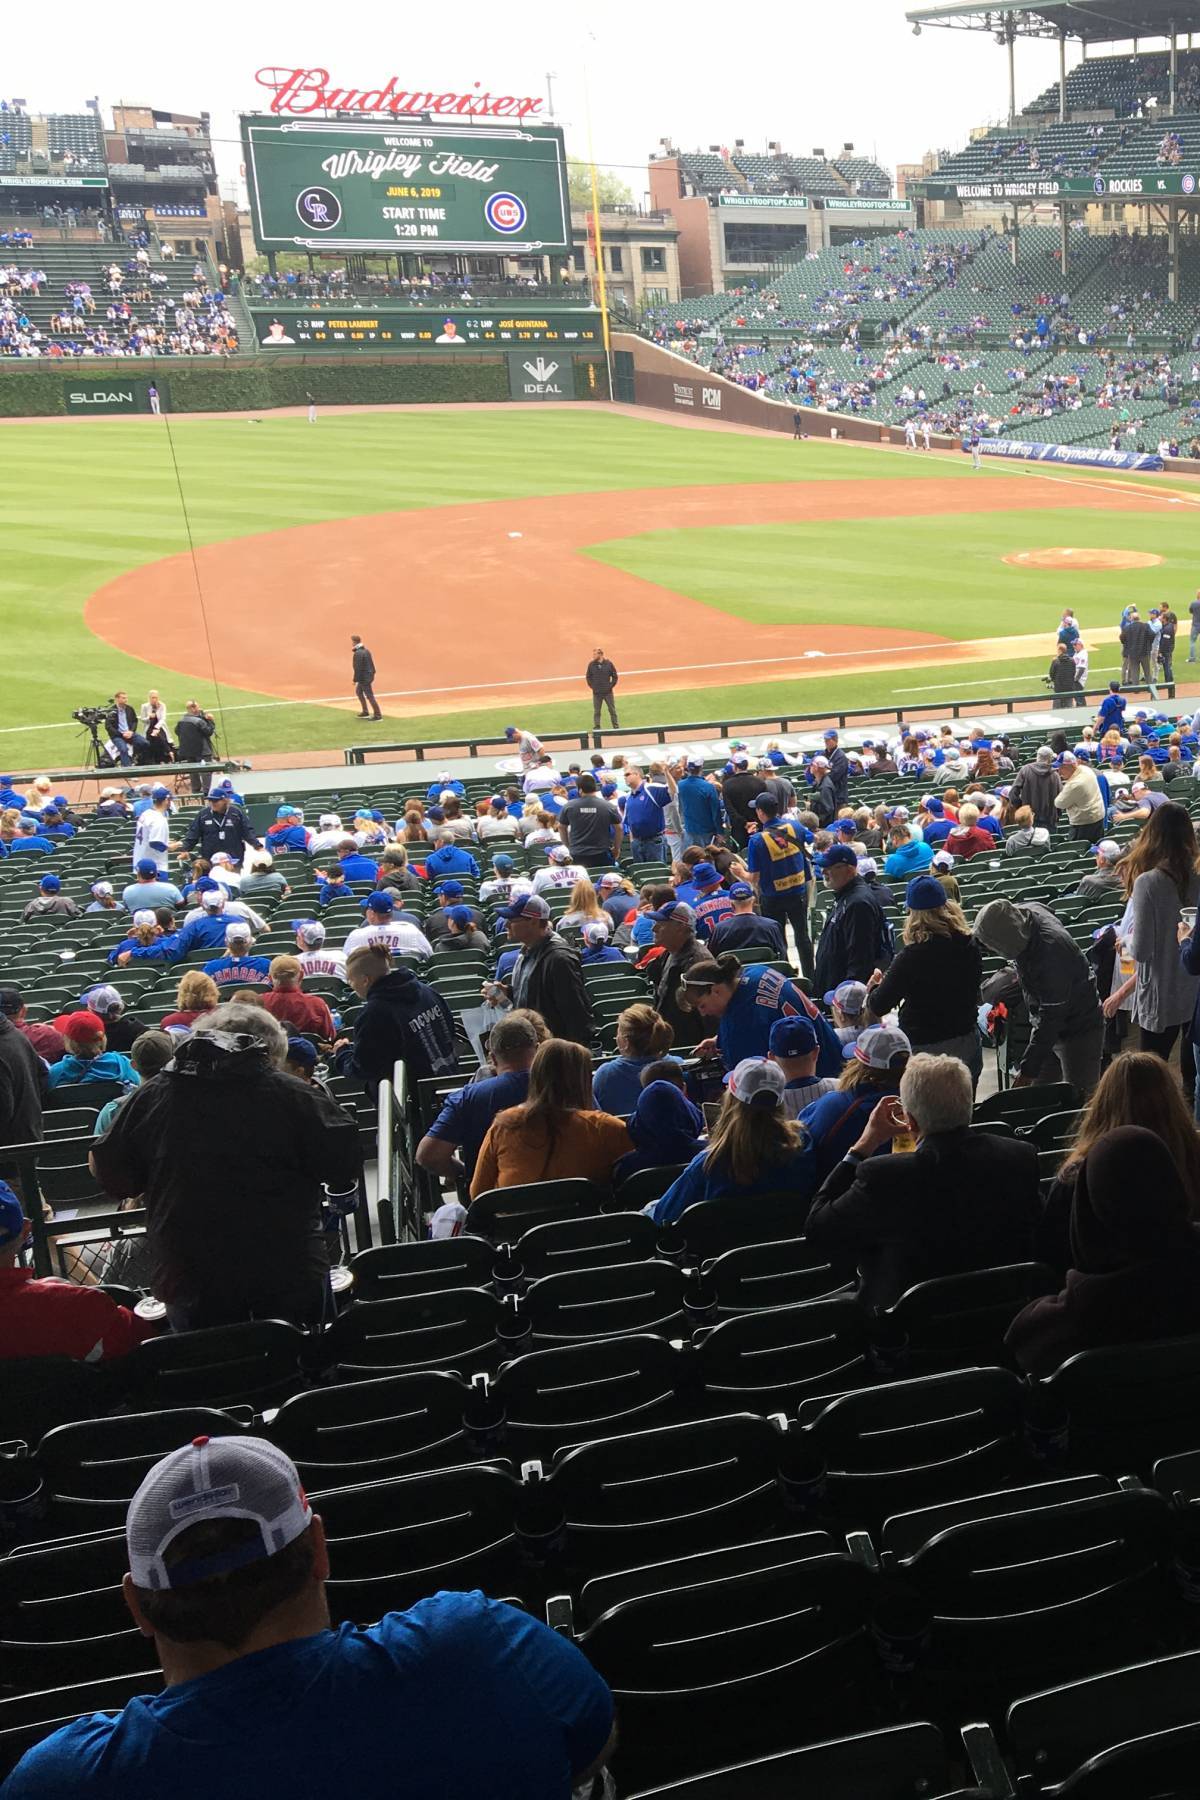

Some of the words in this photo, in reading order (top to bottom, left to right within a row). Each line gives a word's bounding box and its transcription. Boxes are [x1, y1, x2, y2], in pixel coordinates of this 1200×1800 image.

[255, 67, 543, 117] Budweiser
[384, 137, 423, 148] WELCOME
[423, 138, 434, 148] TO
[321, 149, 422, 179] Wrigley
[428, 152, 500, 183] Field
[956, 185, 992, 198] WELCOME
[993, 183, 1003, 197] TO
[1004, 183, 1037, 196] WRIGLEY
[1038, 182, 1060, 195] FIELD
[1109, 179, 1143, 192] ROCKIES
[386, 187, 410, 198] JUNE
[411, 188, 419, 199] 6,
[421, 188, 441, 199] 2019
[724, 197, 804, 207] WRIGLEYROOFTOPS.COM
[829, 199, 907, 210] WRIGLEYROOFTOPS.COM
[383, 207, 419, 220] START
[421, 208, 446, 221] TIME
[394, 224, 417, 237] 1:20
[419, 225, 439, 238] PM
[524, 384, 562, 393] IDEAL
[70, 392, 133, 404] SLOAN
[702, 387, 721, 406] PCM
[1008, 442, 1033, 455] Wrap
[1054, 444, 1097, 460] Reynolds
[1098, 450, 1128, 465] Wrap
